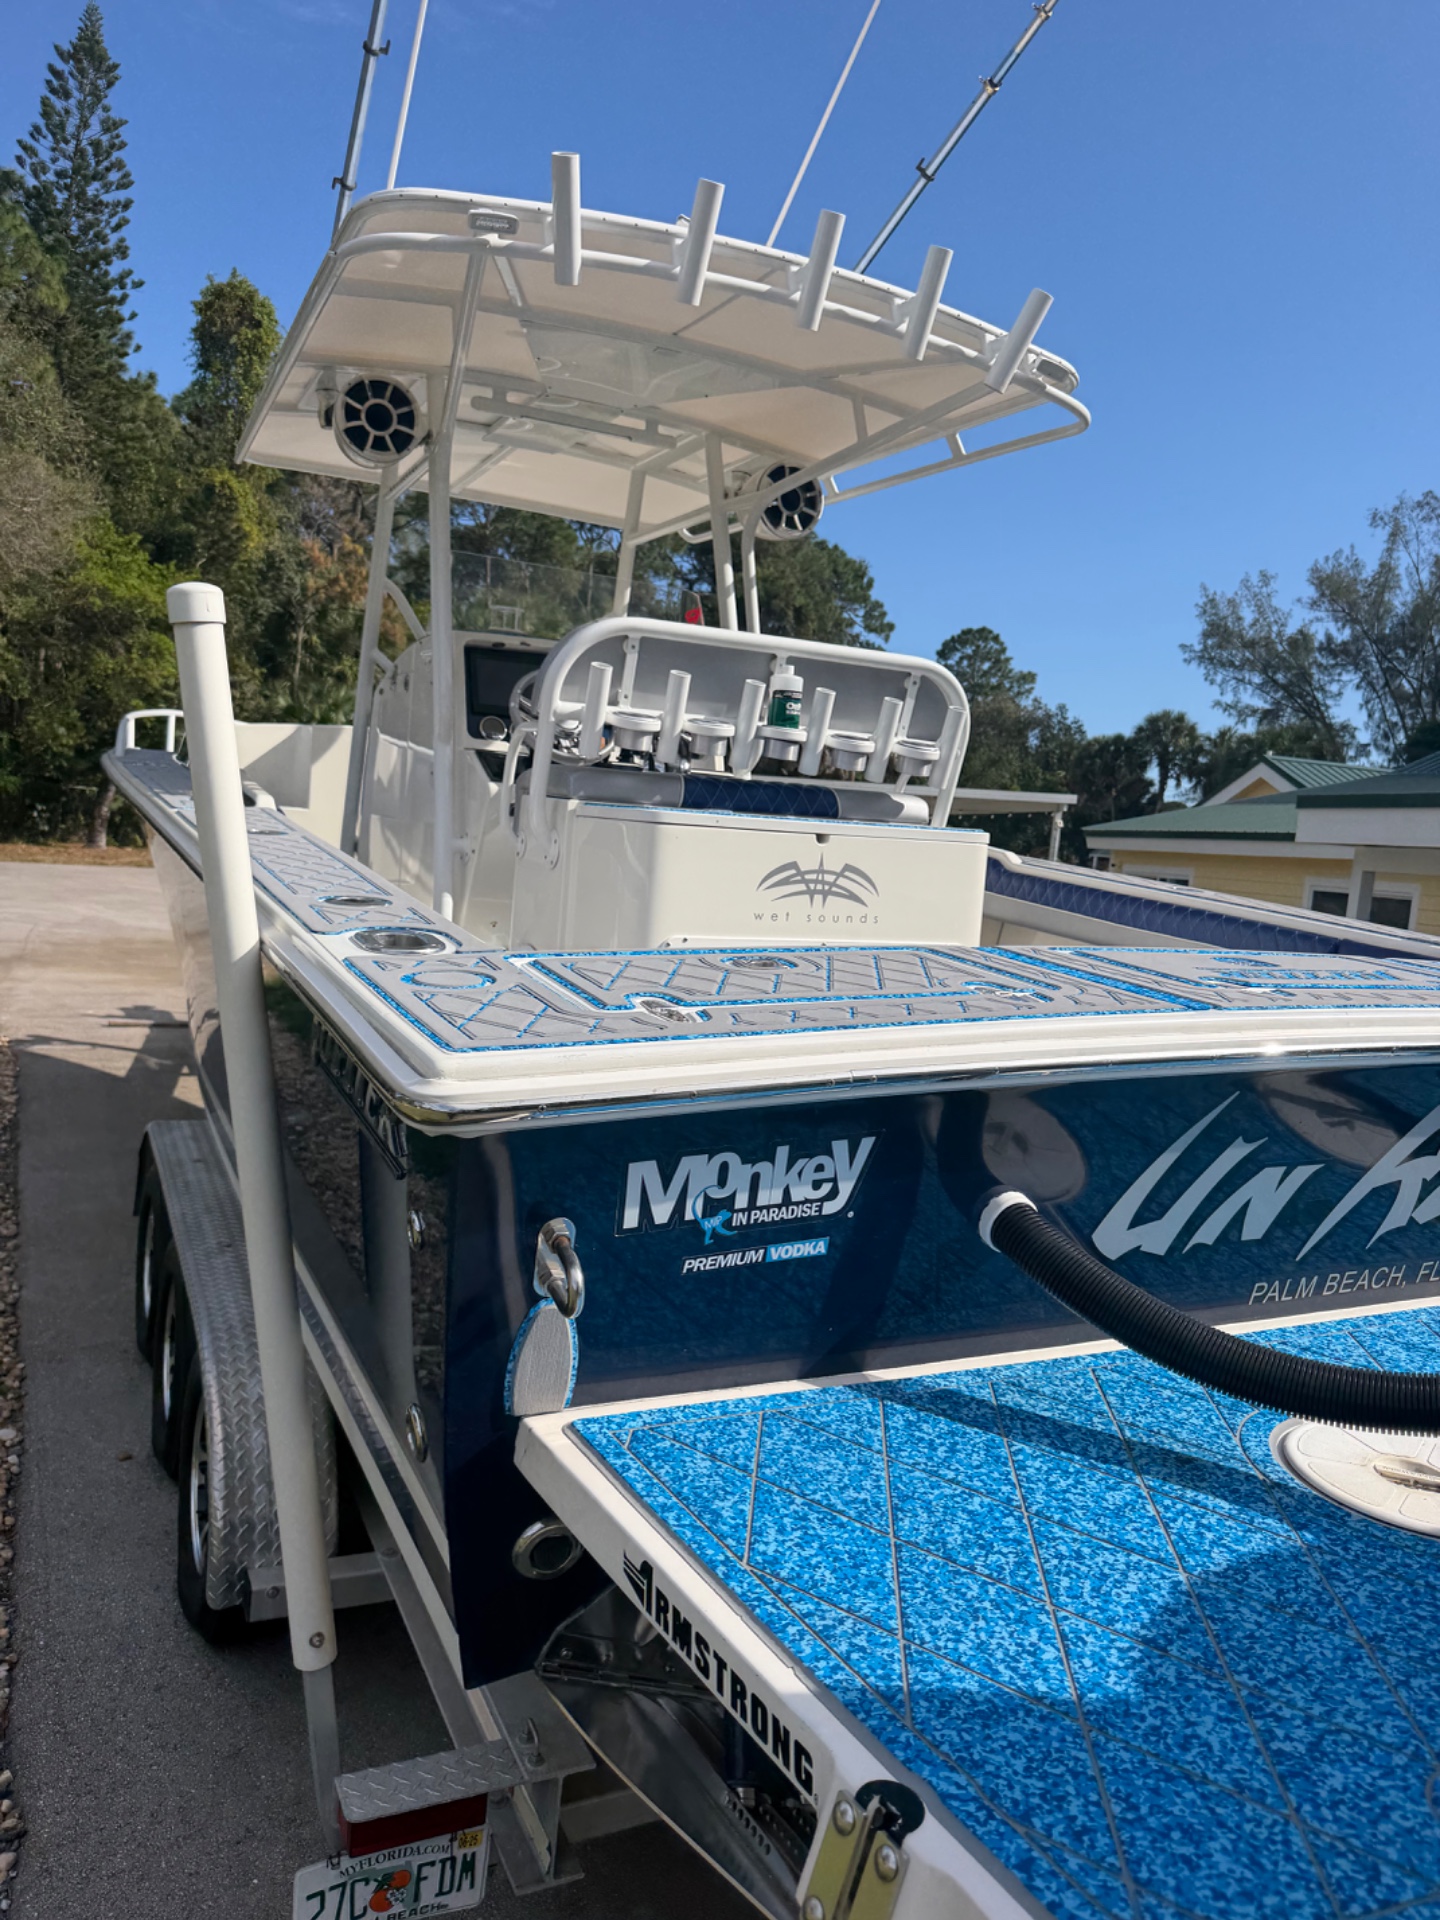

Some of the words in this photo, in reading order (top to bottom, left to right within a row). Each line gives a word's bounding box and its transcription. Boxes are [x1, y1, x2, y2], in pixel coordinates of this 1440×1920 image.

[753, 911, 790, 922] wet
[806, 913, 879, 924] sounds
[622, 1135, 877, 1230] Monkey
[731, 1210, 748, 1227] IN
[750, 1202, 823, 1224] PARADISE
[682, 1248, 766, 1274] PREMIUM
[769, 1240, 827, 1260] VODKA
[1248, 1275, 1319, 1306] PALM
[1322, 1264, 1406, 1297] BEACH,
[412, 1851, 478, 1904] FDM
